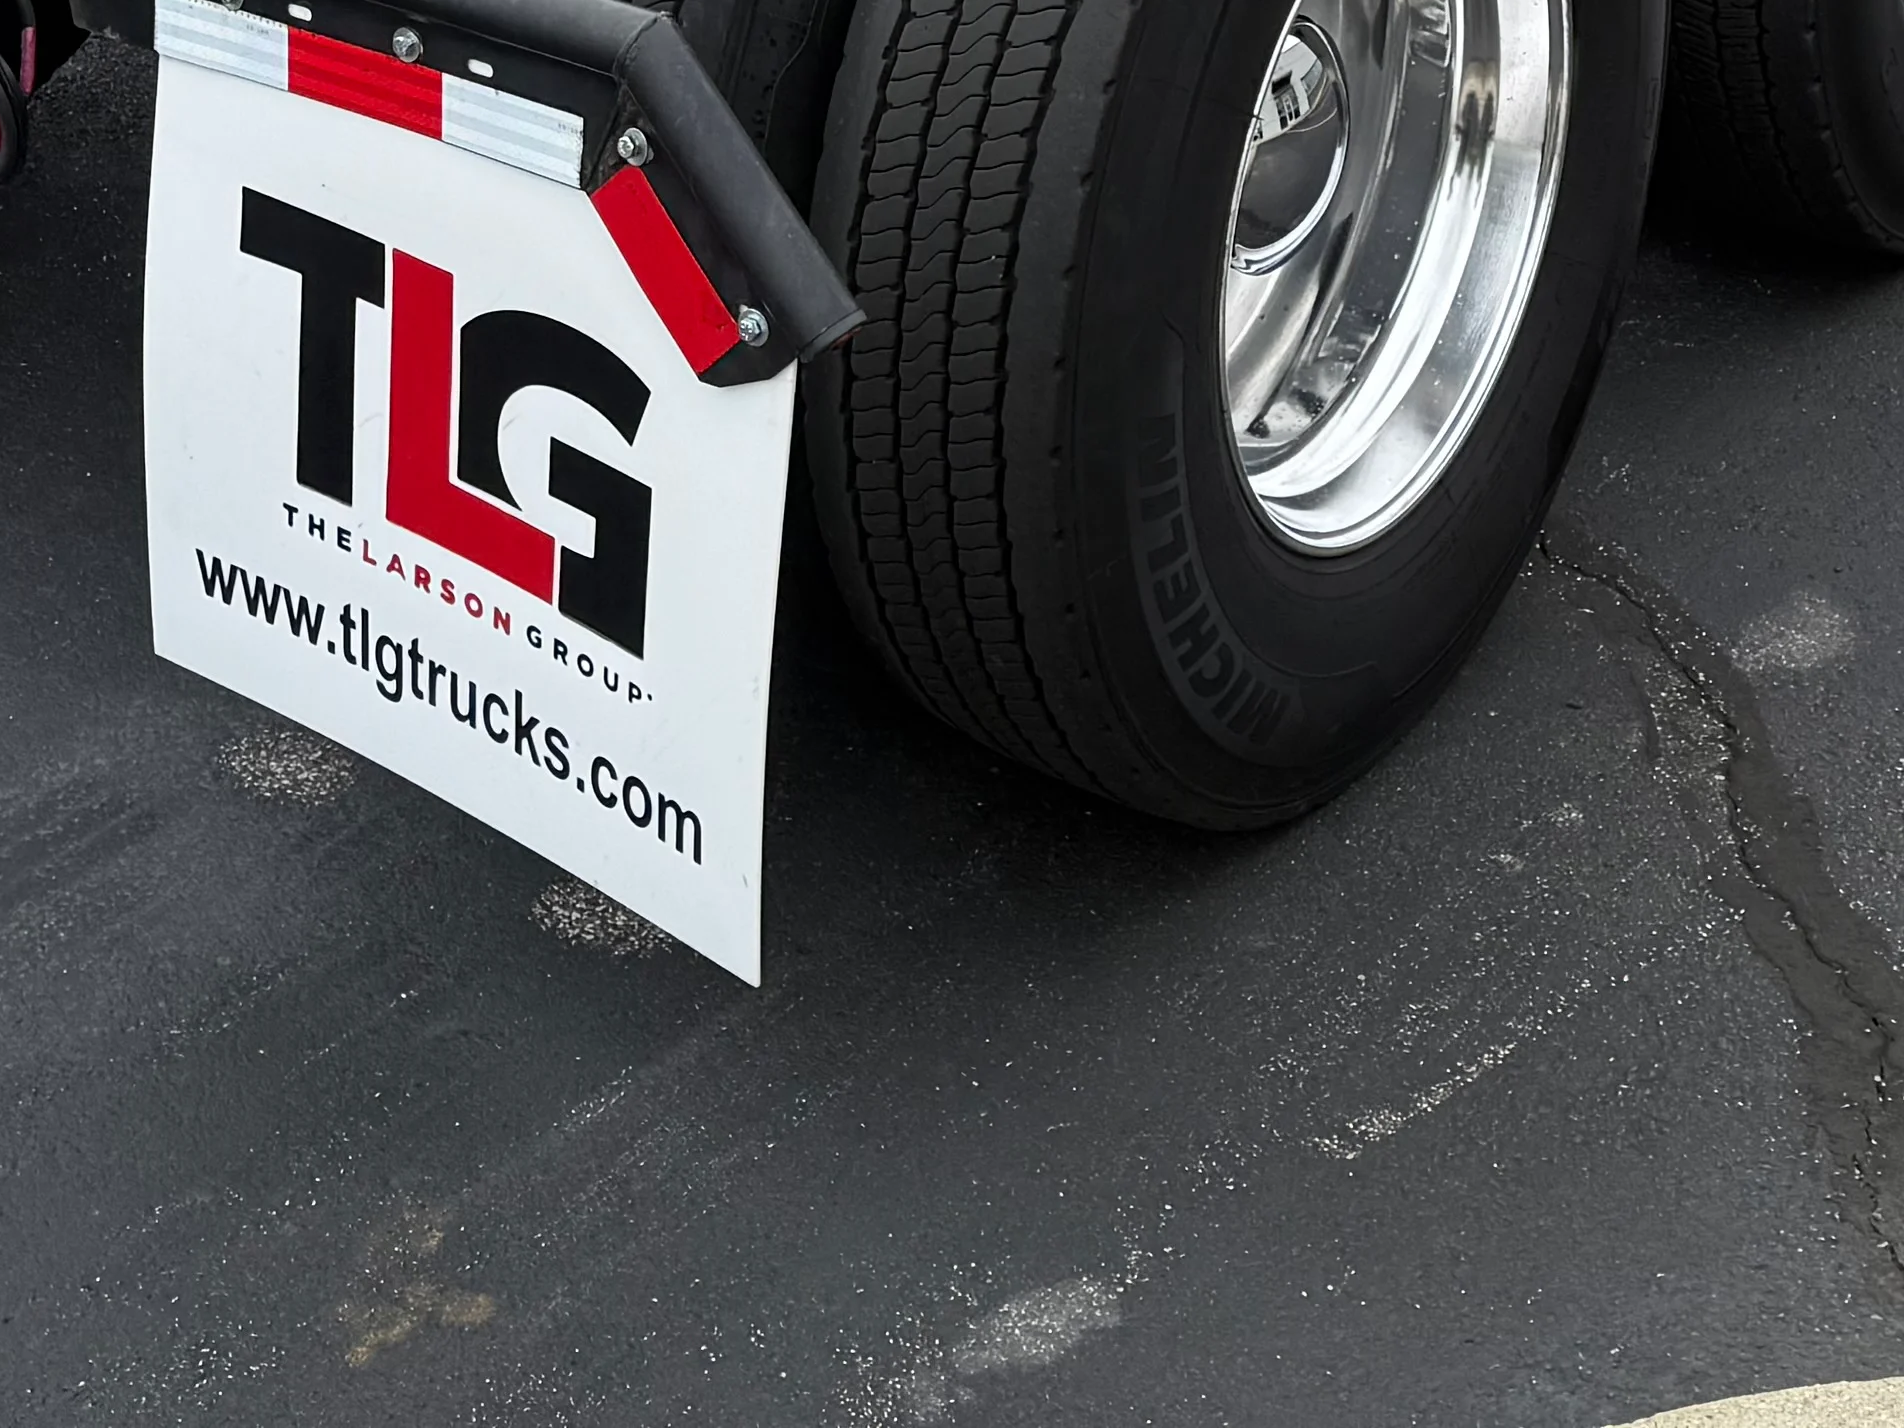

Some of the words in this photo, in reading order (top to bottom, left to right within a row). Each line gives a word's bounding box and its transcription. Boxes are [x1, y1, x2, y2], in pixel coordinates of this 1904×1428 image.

[239, 186, 653, 661] TLG
[1138, 414, 1292, 747] MICHELIN
[194, 547, 704, 866] www.tlgtrucks.com
[525, 624, 644, 705] GROUP
